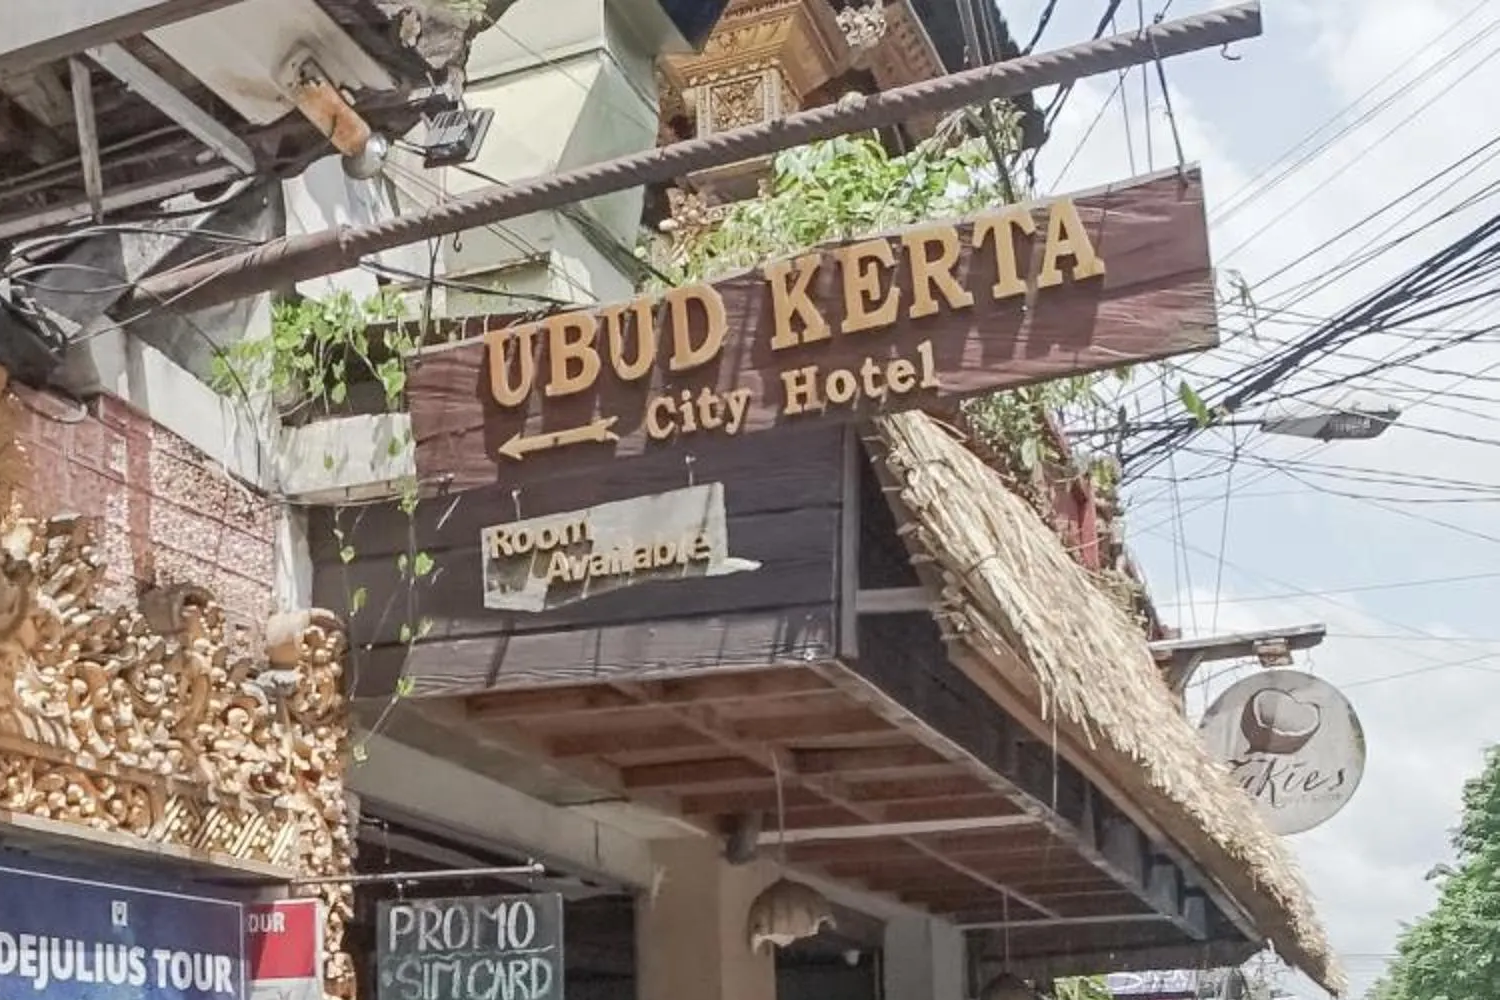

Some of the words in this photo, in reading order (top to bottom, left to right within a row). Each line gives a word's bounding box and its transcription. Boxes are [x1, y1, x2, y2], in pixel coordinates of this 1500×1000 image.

[484, 284, 728, 407] UBUD
[765, 199, 1105, 350] KERTA
[645, 386, 753, 440] City
[781, 340, 939, 414] Hotel
[490, 518, 593, 558] Room
[546, 529, 711, 583] Available
[248, 911, 286, 933] OUR
[389, 902, 536, 951] PROMO
[153, 949, 234, 993] TOUR
[396, 960, 460, 1000] SIM
[467, 957, 554, 1000] CARD
